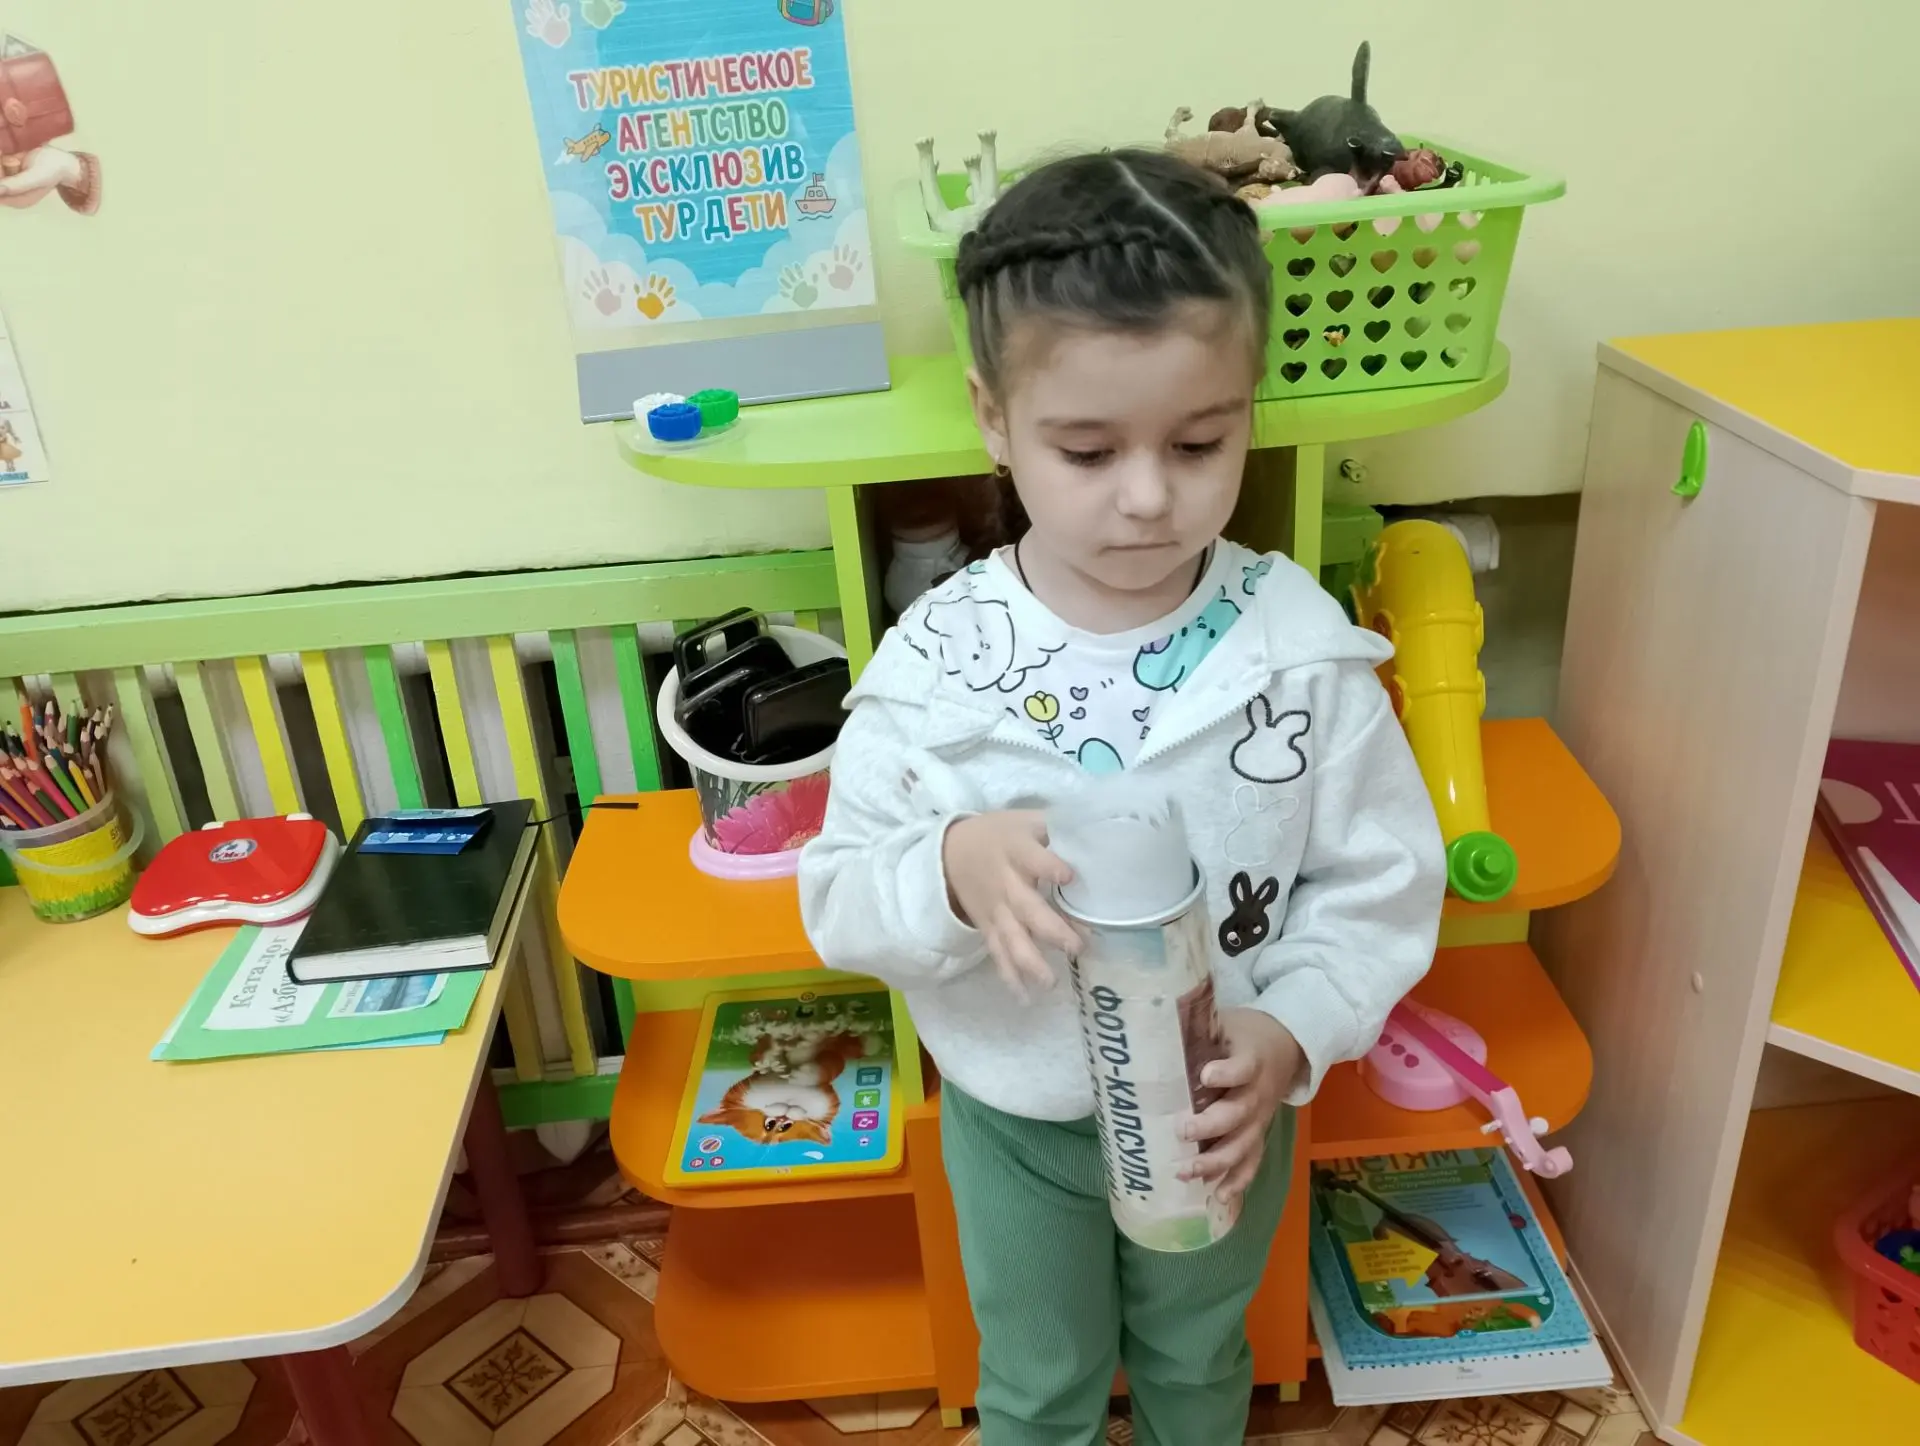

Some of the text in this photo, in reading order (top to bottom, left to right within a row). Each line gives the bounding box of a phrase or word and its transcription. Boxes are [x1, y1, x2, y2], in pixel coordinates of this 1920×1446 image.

[569, 50, 813, 108] ТУРИСТИЧЕСКОЕ
[618, 100, 787, 152] АГЕНТСТВО
[607, 145, 805, 199] ЭКСКЛЮЗИВ
[636, 192, 787, 242] ТУР ДЕТИ
[229, 936, 287, 1009] Каталог
[1089, 985, 1154, 1201] ФОТО-КАПСУЛА:
